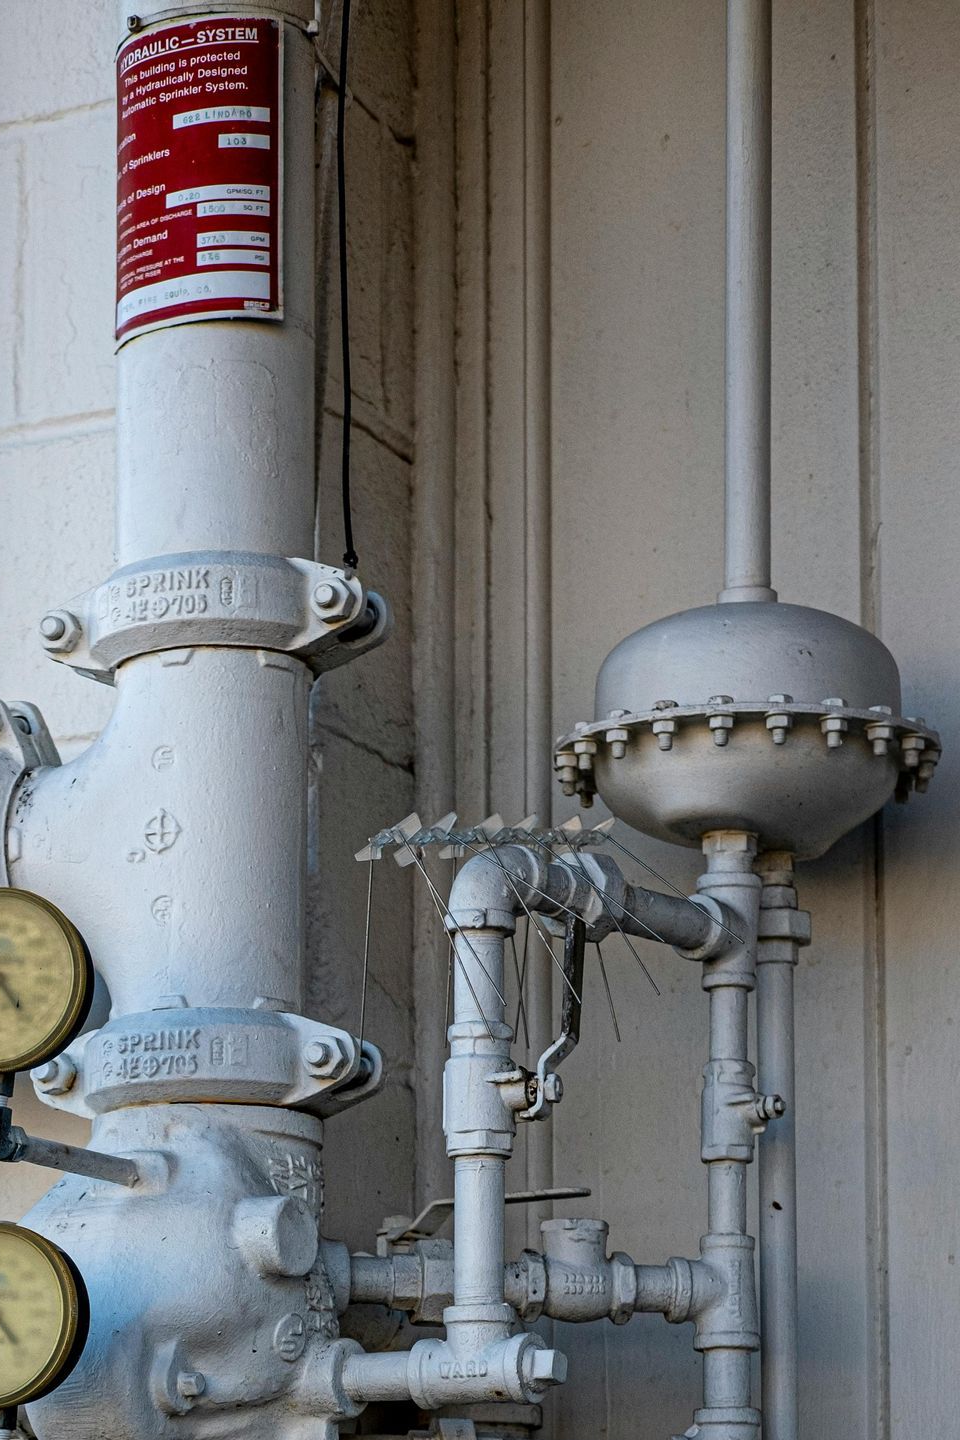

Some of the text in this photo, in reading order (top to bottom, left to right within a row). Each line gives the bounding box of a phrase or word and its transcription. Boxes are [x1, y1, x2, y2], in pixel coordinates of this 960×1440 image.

[196, 27, 258, 43] SYSTEM
[124, 50, 240, 88] This building is protected
[129, 92, 134, 100] a
[136, 71, 194, 97] Hydraulically
[197, 66, 248, 79] Designed
[121, 81, 248, 120] Automatic Sprinkler System.
[227, 137, 247, 145] 103
[128, 148, 170, 170] Sprinklers
[136, 184, 166, 200] Design
[133, 229, 168, 249] Demand
[126, 568, 210, 598] SPRINK
[117, 1028, 201, 1054] SPRINK
